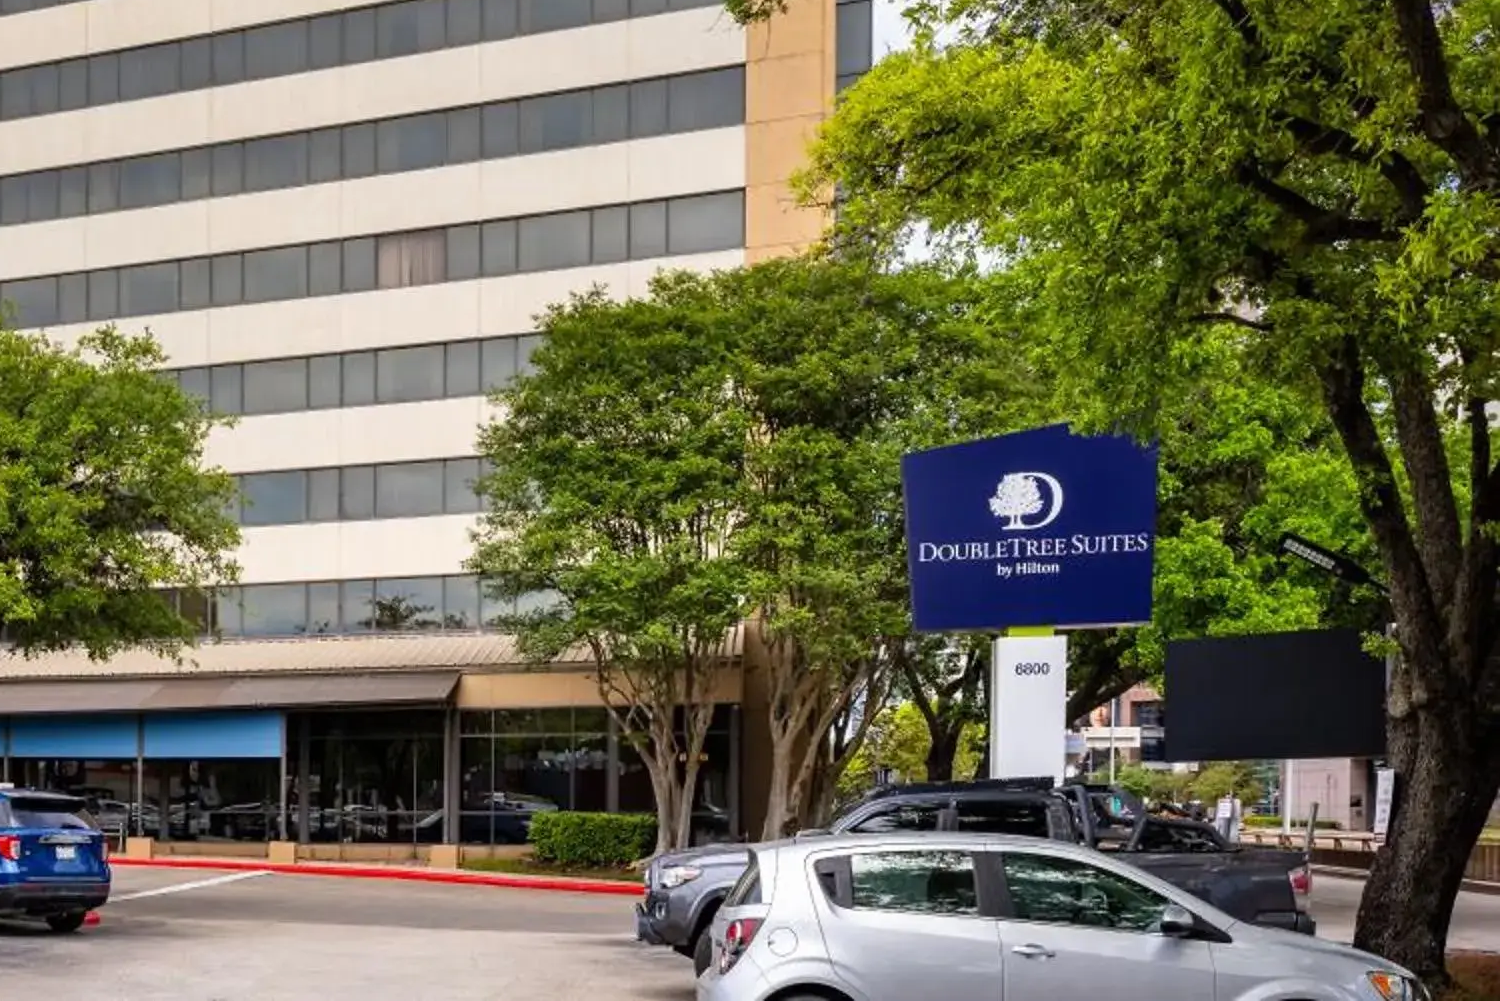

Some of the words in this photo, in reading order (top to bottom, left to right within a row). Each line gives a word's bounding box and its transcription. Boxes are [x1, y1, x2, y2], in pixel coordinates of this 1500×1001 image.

[918, 537, 1067, 563] DOUBLETREE
[1070, 532, 1149, 555] SUITES
[996, 563, 1013, 579] by
[1015, 561, 1060, 575] Hilton
[1015, 662, 1051, 676] 6800
